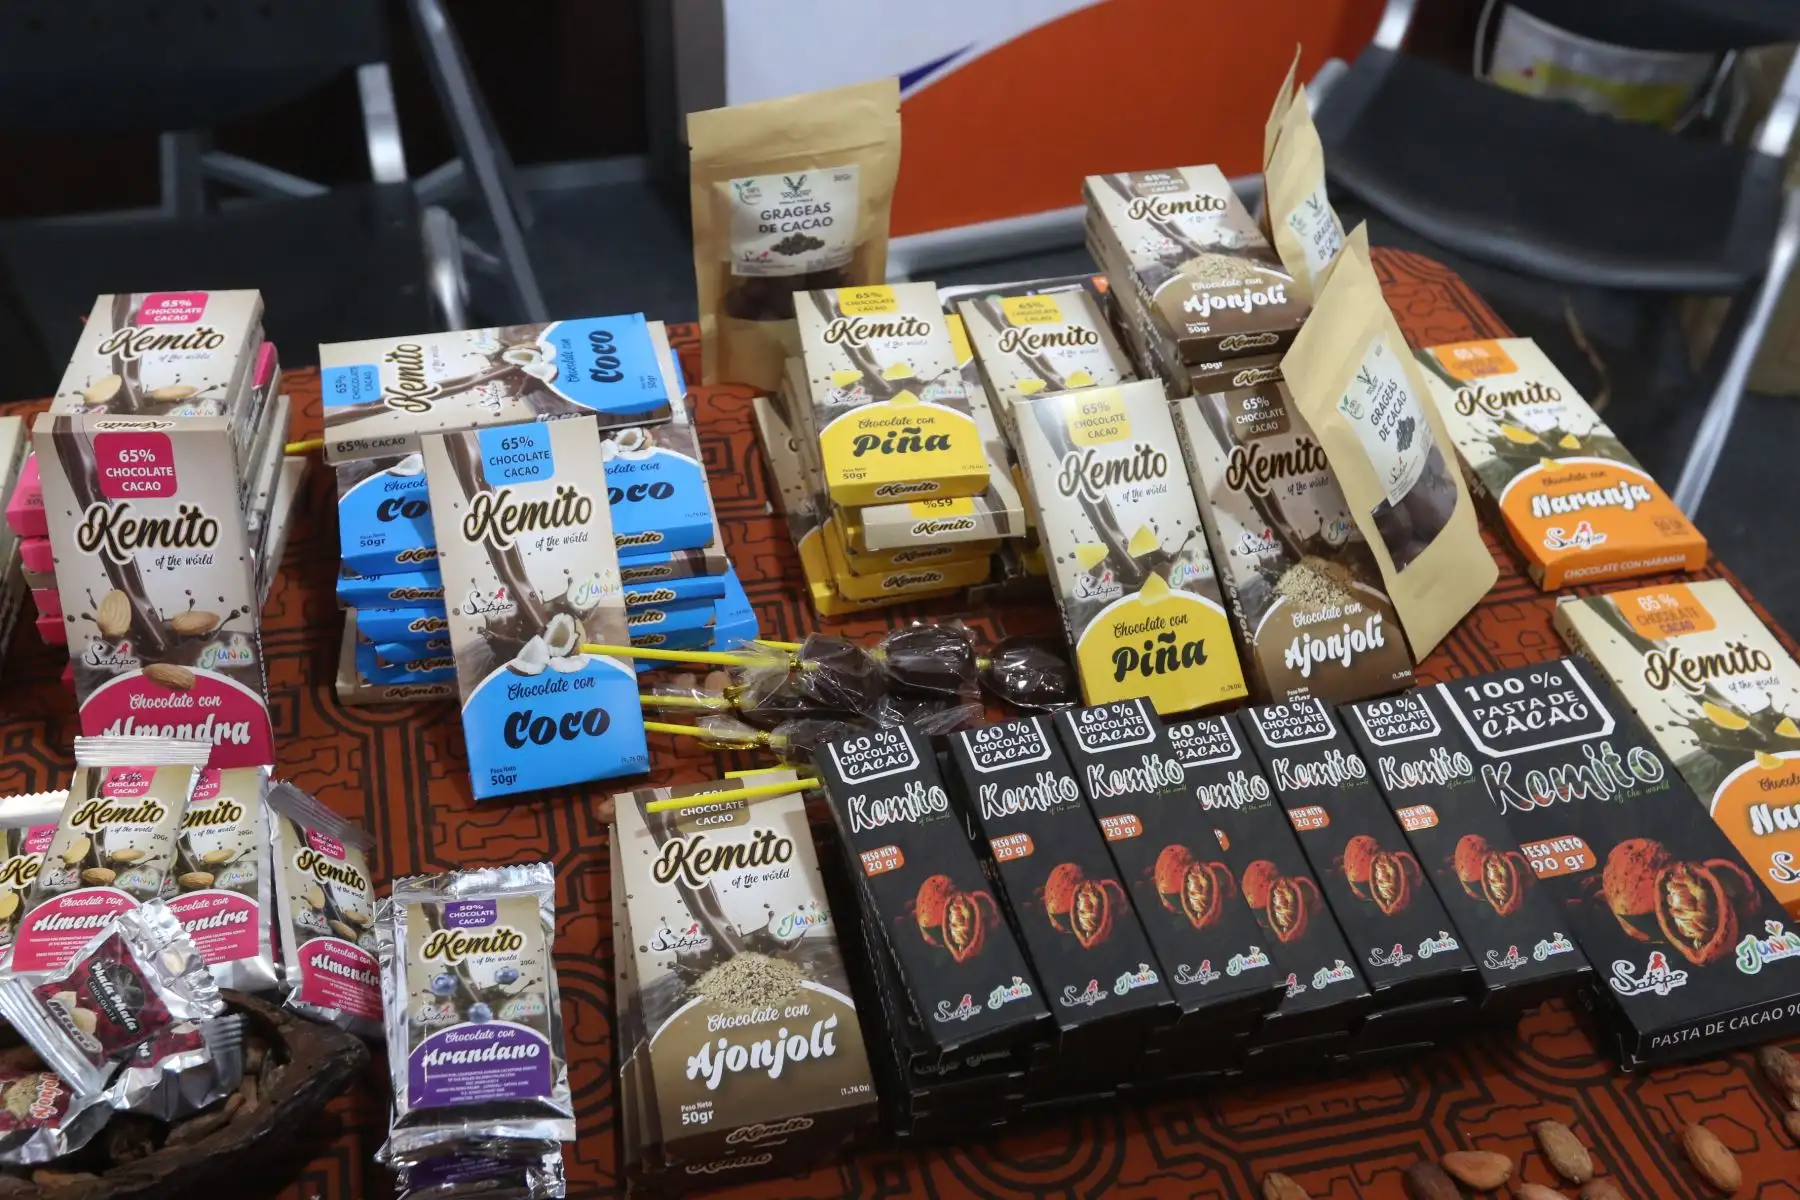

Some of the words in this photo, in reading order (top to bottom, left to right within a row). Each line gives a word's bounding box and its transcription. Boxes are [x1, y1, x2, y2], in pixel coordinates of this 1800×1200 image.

[760, 202, 831, 222] GRAGEAS
[1127, 194, 1227, 222] Kemito
[758, 223, 778, 234] DE
[780, 216, 834, 234] CACAO
[1192, 279, 1242, 291] Chocolate
[1245, 278, 1264, 286] con
[145, 307, 202, 316] CHOCOLATE
[161, 299, 192, 308] 65%
[154, 314, 189, 322] CACAO
[823, 316, 931, 346] Kemito
[1187, 325, 1211, 334] 50gr
[98, 326, 226, 360] Kemito
[999, 325, 1098, 356] Kemito
[1220, 335, 1279, 350] Kemito
[588, 330, 624, 383] Coco
[1201, 361, 1223, 370] 50gr
[564, 351, 580, 383] Chocolate
[385, 343, 441, 413] Kemito
[1081, 401, 1111, 415] 65%
[1242, 396, 1270, 411] 65%
[1371, 379, 1398, 426] GRAGEAS
[1454, 381, 1562, 417] Kemito
[858, 416, 912, 430] Chocolate
[916, 416, 935, 425] con
[1074, 413, 1127, 429] CHOCOLATE
[1235, 408, 1286, 425] CHOCOLATE
[1378, 423, 1391, 442] DE
[1387, 390, 1407, 428] CACAO
[1087, 427, 1118, 439] CACAO
[1249, 421, 1279, 435] CACAO
[336, 438, 369, 453] 65%
[371, 436, 406, 448] CACAO
[501, 435, 534, 451] 65%
[852, 427, 952, 458] Piña
[118, 449, 156, 463] 65%
[489, 450, 551, 467] CHOCOLATE
[105, 466, 174, 478] CHOCOLATE
[504, 465, 540, 479] CACAO
[640, 461, 661, 472] con
[842, 471, 868, 480] 50gr
[1058, 443, 1168, 501] Kemito
[1225, 438, 1328, 495] Kemito
[121, 481, 162, 492] CACAO
[876, 481, 938, 497] Kemito
[1531, 480, 1652, 518] Naranja
[462, 485, 593, 547] Kemito
[76, 502, 219, 562] Kemito
[913, 519, 975, 535] Kemito
[360, 538, 386, 548] 50gr
[1564, 563, 1619, 579] CHOCOLATE
[1620, 560, 1642, 573] CON
[1643, 554, 1687, 567] NARANJA
[883, 572, 942, 588] Kemito
[1637, 595, 1662, 611] 65
[1661, 592, 1679, 609] %
[1291, 604, 1342, 628] Chocolate
[1344, 602, 1363, 615] con
[1636, 606, 1700, 626] CHOCOLATE
[1112, 617, 1166, 639] Chocolate
[1169, 614, 1189, 627] con
[1659, 620, 1696, 634] CACAO
[1111, 630, 1209, 683] Piña
[1644, 641, 1772, 692] Kemito
[507, 677, 570, 702] Chocolate
[573, 675, 596, 690] con
[1464, 676, 1526, 703] 100
[1529, 671, 1563, 690] %
[129, 692, 195, 710] Chocolate
[198, 694, 222, 708] con
[1263, 705, 1290, 721] 60
[1292, 700, 1314, 715] %
[1367, 702, 1394, 718] 60
[1396, 698, 1418, 712] %
[1472, 696, 1547, 722] PASTA
[1548, 689, 1580, 706] DE
[1081, 707, 1108, 724] 60
[1111, 703, 1134, 717] %
[1262, 712, 1324, 730] CHOCOLATE
[1366, 709, 1428, 729] CHOCOLATE
[1481, 701, 1590, 740] CACAO
[103, 713, 251, 746] Almendra
[503, 707, 611, 750] Coco
[976, 726, 1003, 743] 60
[1007, 721, 1029, 734] %
[1078, 716, 1144, 735] CHOCOLATE
[1086, 725, 1146, 746] CACAO
[1168, 724, 1195, 740] 60
[1198, 720, 1220, 734] %
[1270, 723, 1326, 741] CACAO
[1375, 718, 1431, 739] CACAO
[843, 736, 870, 754] 60
[874, 730, 897, 745] %
[972, 732, 1039, 754] CHOCOLATE
[840, 742, 907, 766] CHOCOLATE
[981, 743, 1041, 764] CACAO
[849, 752, 909, 776] CACAO
[1271, 748, 1367, 792] Kemito
[1378, 746, 1474, 792] Kemito
[490, 771, 518, 788] 50gr
[1086, 753, 1185, 800] Kemito
[1480, 740, 1666, 816] Kemito
[979, 770, 1080, 821] Kemito
[71, 799, 166, 830] Kemito
[181, 799, 243, 829] emito
[680, 799, 745, 817] CHOCOLATE
[847, 780, 949, 834] Kemito
[695, 813, 734, 827] CACAO
[1101, 817, 1120, 828] PESO
[1119, 815, 1136, 826] NETO
[1296, 816, 1310, 828] 20
[1312, 816, 1324, 828] gr
[1107, 826, 1121, 838] 20
[1123, 825, 1137, 837] gr
[992, 838, 1010, 850] PESO
[1010, 834, 1028, 846] NETO
[1551, 836, 1584, 853] NETO
[653, 829, 793, 886] Kemito
[998, 847, 1012, 859] 20
[1015, 846, 1027, 858] gr
[297, 849, 366, 892] Kemito
[868, 860, 883, 872] 20
[886, 858, 898, 870] gr
[1530, 856, 1559, 874] 90
[1563, 852, 1585, 872] gr
[59, 895, 105, 908] Chocolate
[105, 896, 125, 906] con
[212, 896, 229, 906] con
[449, 909, 495, 919] CHOCOLATE
[458, 917, 486, 926] CACAO
[322, 940, 359, 962] Chocolate
[423, 927, 524, 962] Kemito
[706, 1005, 780, 1033] Chocolate
[784, 1003, 811, 1019] con
[445, 1029, 495, 1044] Chocolate
[497, 1028, 517, 1039] con
[1651, 1026, 1702, 1049] PASTA
[1704, 1020, 1725, 1037] DE
[1729, 1008, 1783, 1031] CACAO
[421, 1041, 541, 1068] Arandano
[685, 1012, 838, 1091] Ajonjolí
[680, 1102, 696, 1112] Peso
[695, 1099, 713, 1110] Neto
[681, 1109, 715, 1126] 50gr
[726, 1117, 815, 1144] Kemito
